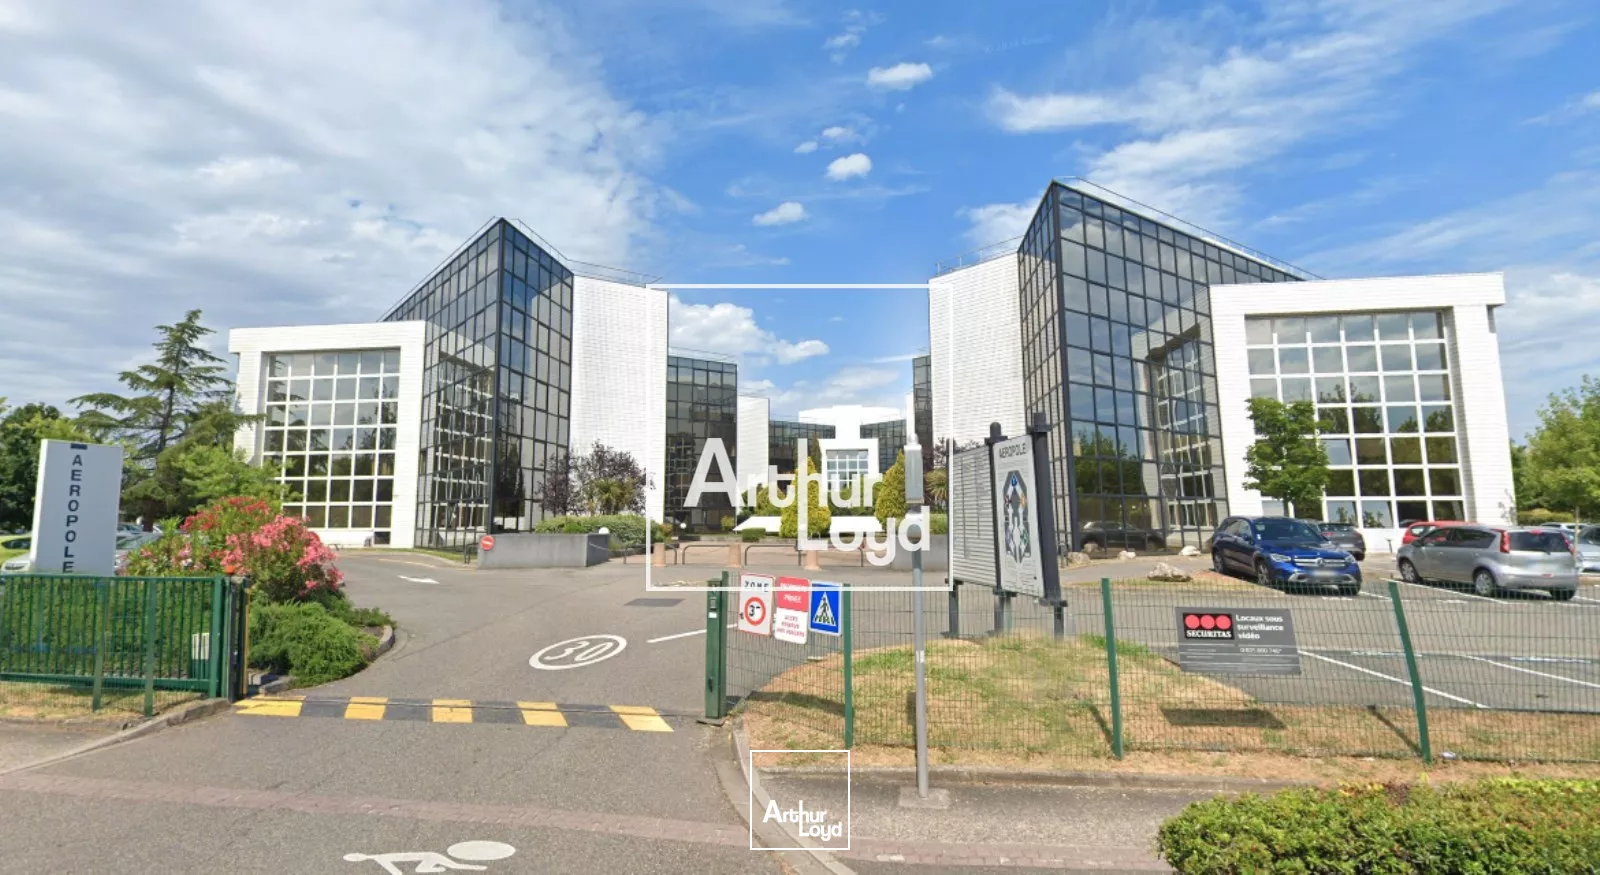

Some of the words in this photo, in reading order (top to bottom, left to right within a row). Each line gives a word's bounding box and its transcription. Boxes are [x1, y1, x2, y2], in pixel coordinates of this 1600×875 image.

[62, 454, 83, 574] AEROPOLE
[1235, 614, 1264, 622] Locaux
[1236, 623, 1285, 631] surveillance
[1186, 629, 1232, 639] SECURITAS
[544, 641, 613, 661] 30
